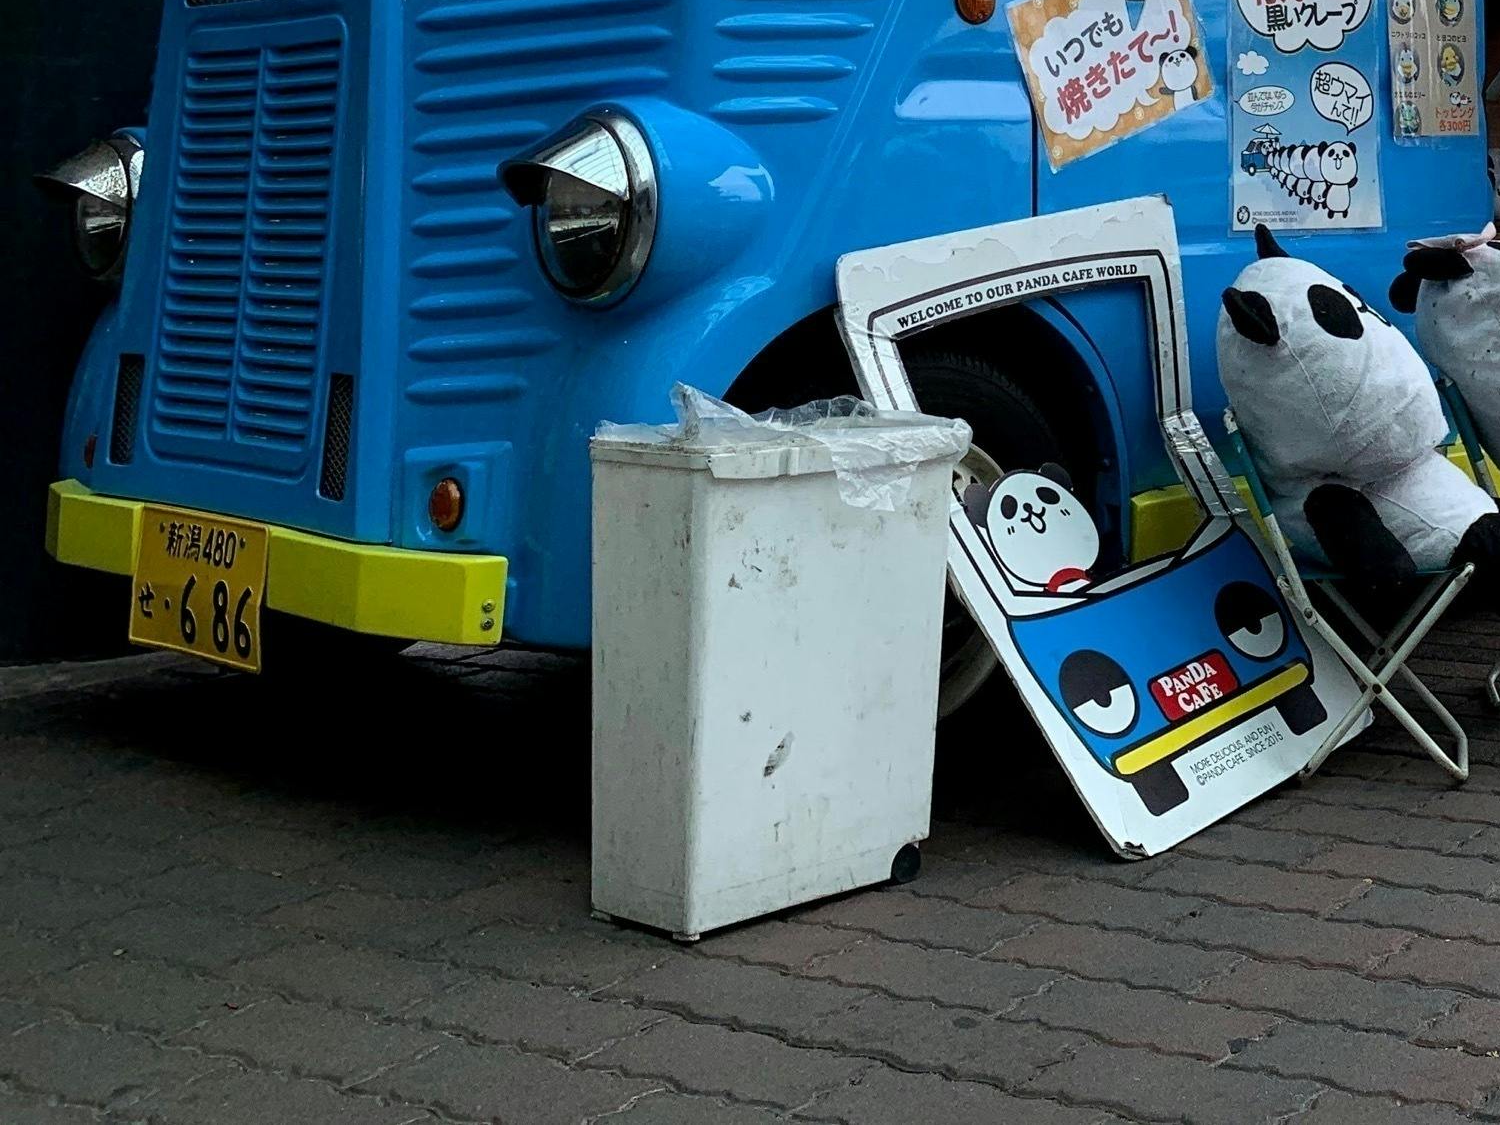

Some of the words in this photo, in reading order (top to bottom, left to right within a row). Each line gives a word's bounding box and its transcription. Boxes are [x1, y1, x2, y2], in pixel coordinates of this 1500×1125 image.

[1266, 0, 1359, 33] 黒いクレープ
[1044, 11, 1124, 78] いつでも
[1313, 69, 1372, 112] 超ウマイ
[1435, 106, 1476, 119] トッピング
[897, 296, 963, 329] WELCOME
[965, 290, 984, 307] TO
[986, 282, 1014, 300] OUR
[1016, 273, 1060, 293] PANDA
[1062, 266, 1094, 283] CAFE
[1096, 263, 1138, 277] WORLD
[167, 521, 202, 562] 新潟
[203, 527, 238, 569] 480
[138, 581, 155, 619] せ
[1157, 661, 1217, 697] PANDA
[1177, 681, 1223, 713] CAFE
[1189, 757, 1212, 774] MORE
[1243, 730, 1259, 745] AND
[1245, 741, 1267, 759] SINCE
